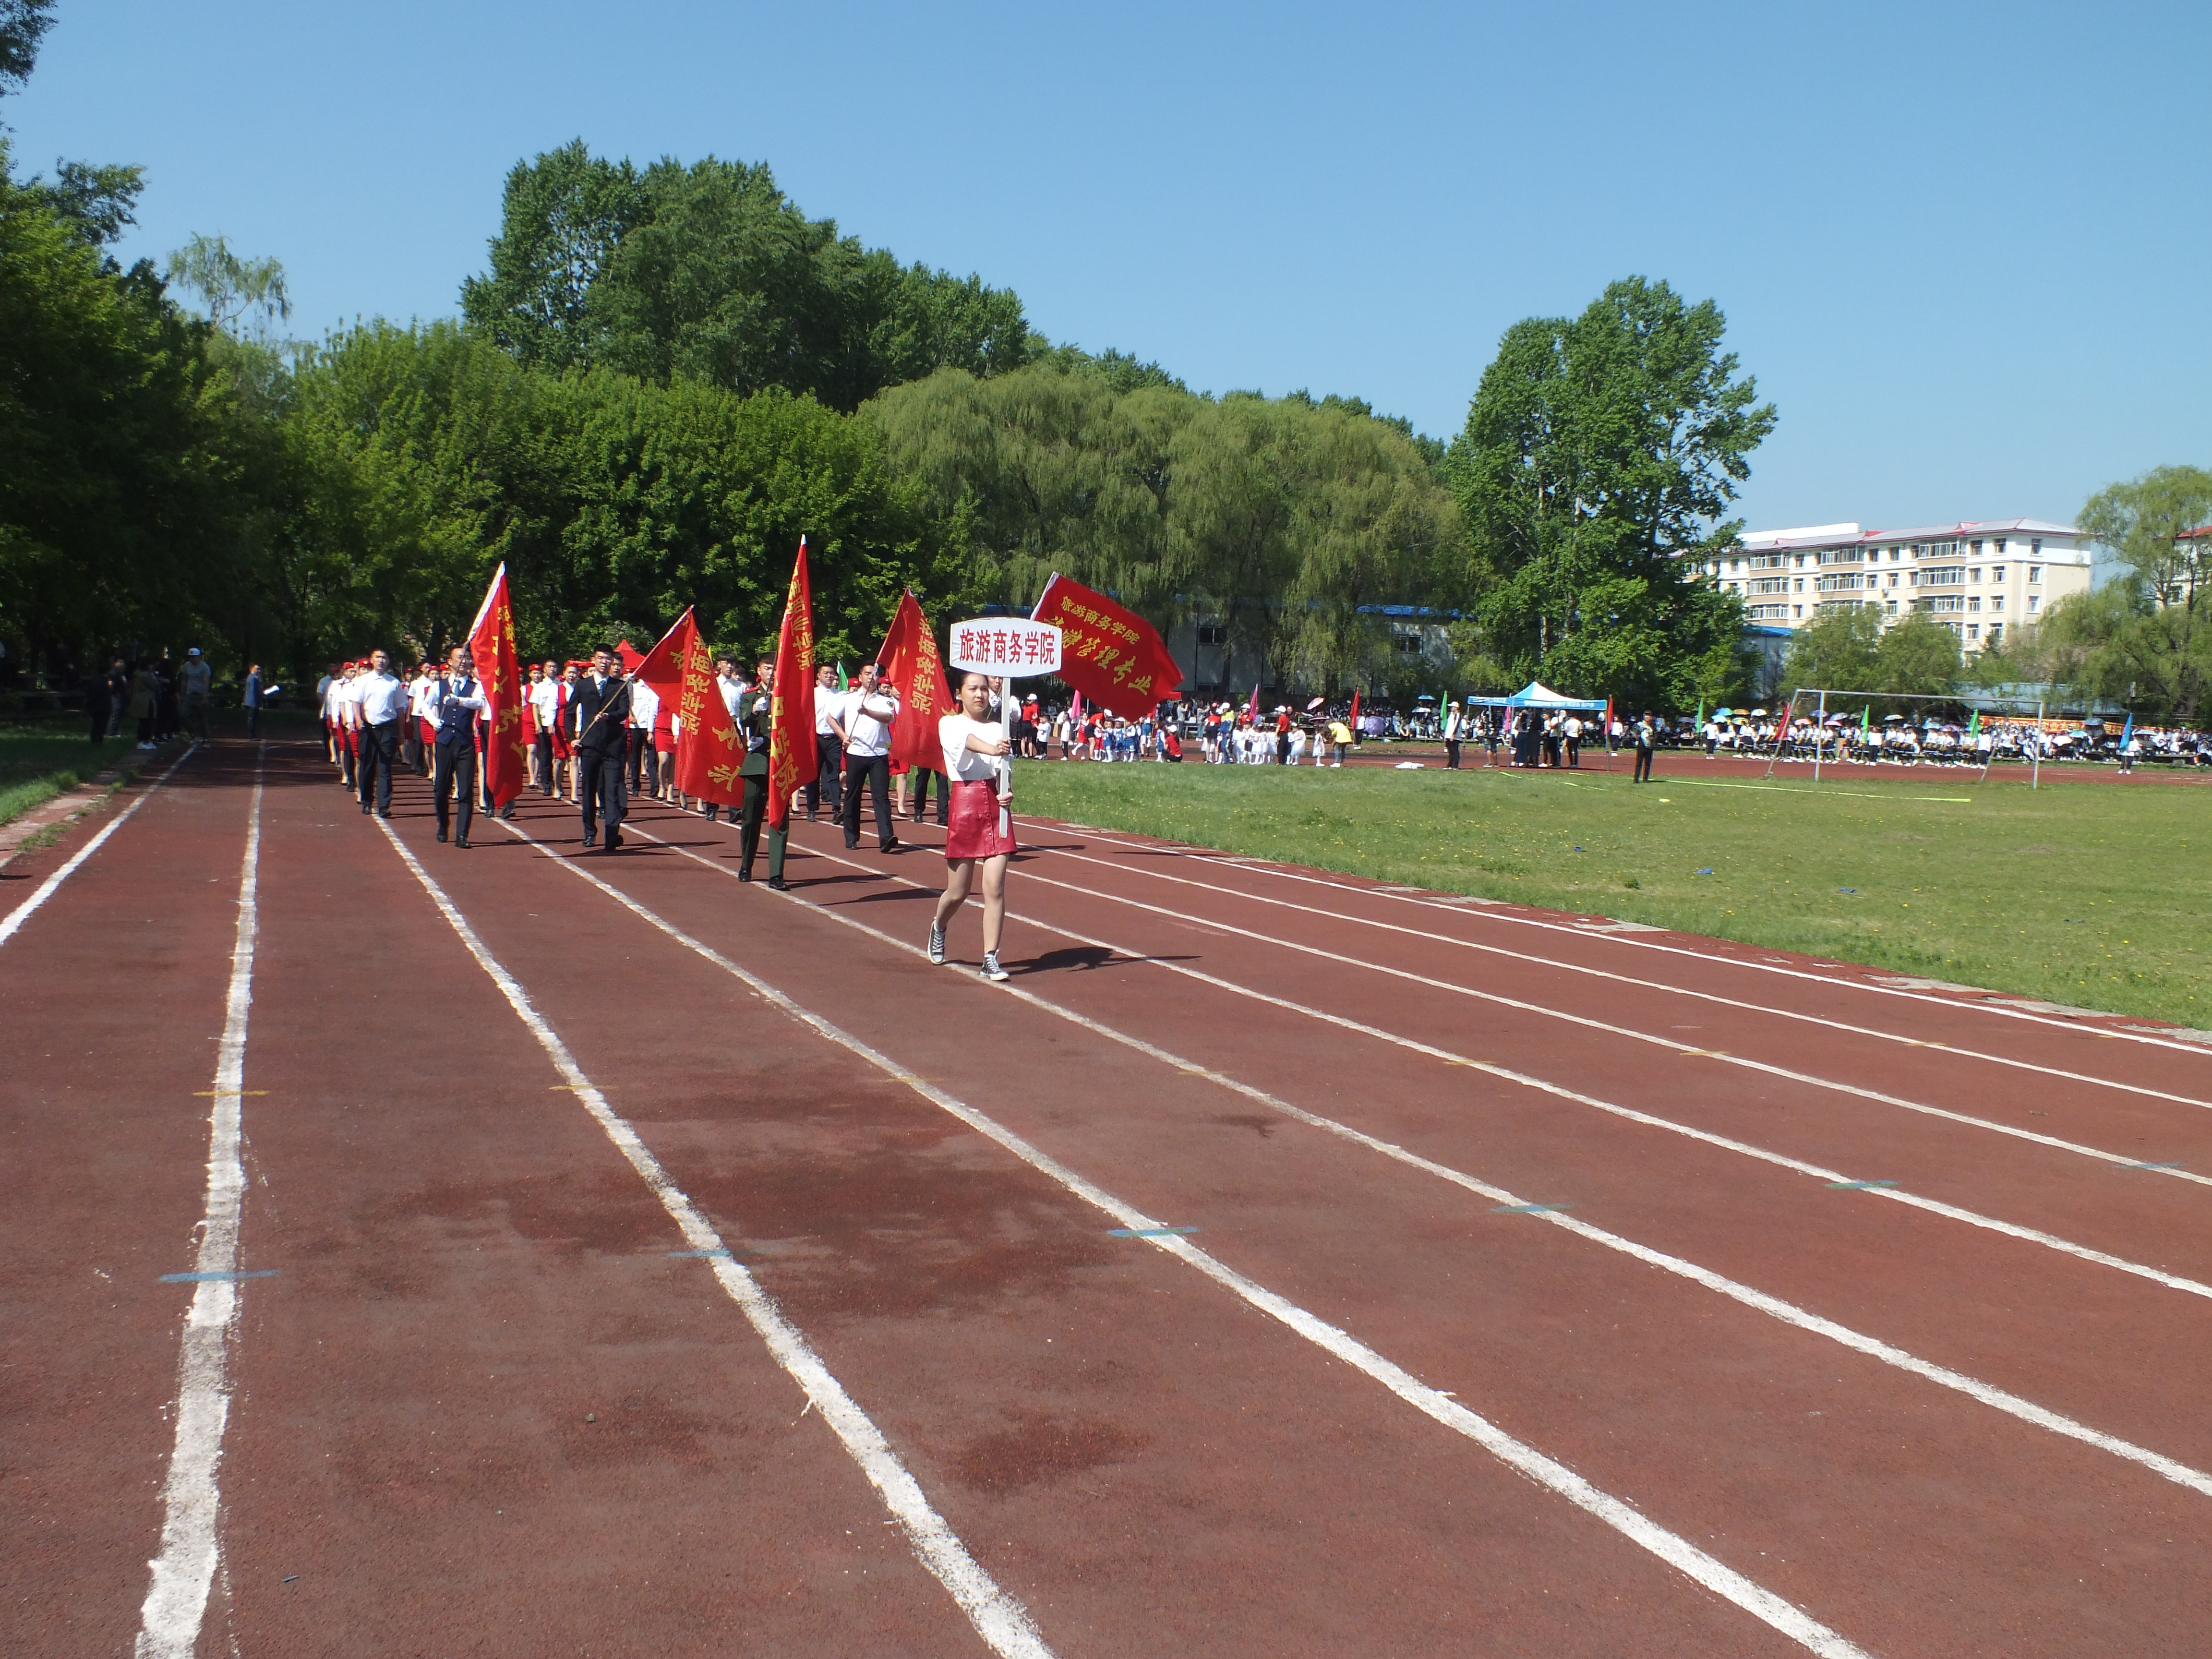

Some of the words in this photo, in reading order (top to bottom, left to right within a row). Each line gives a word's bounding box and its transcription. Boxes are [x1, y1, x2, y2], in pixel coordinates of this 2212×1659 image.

[1060, 596, 1140, 644] 旅游商务学院
[960, 628, 1055, 665] 旅游商务学院
